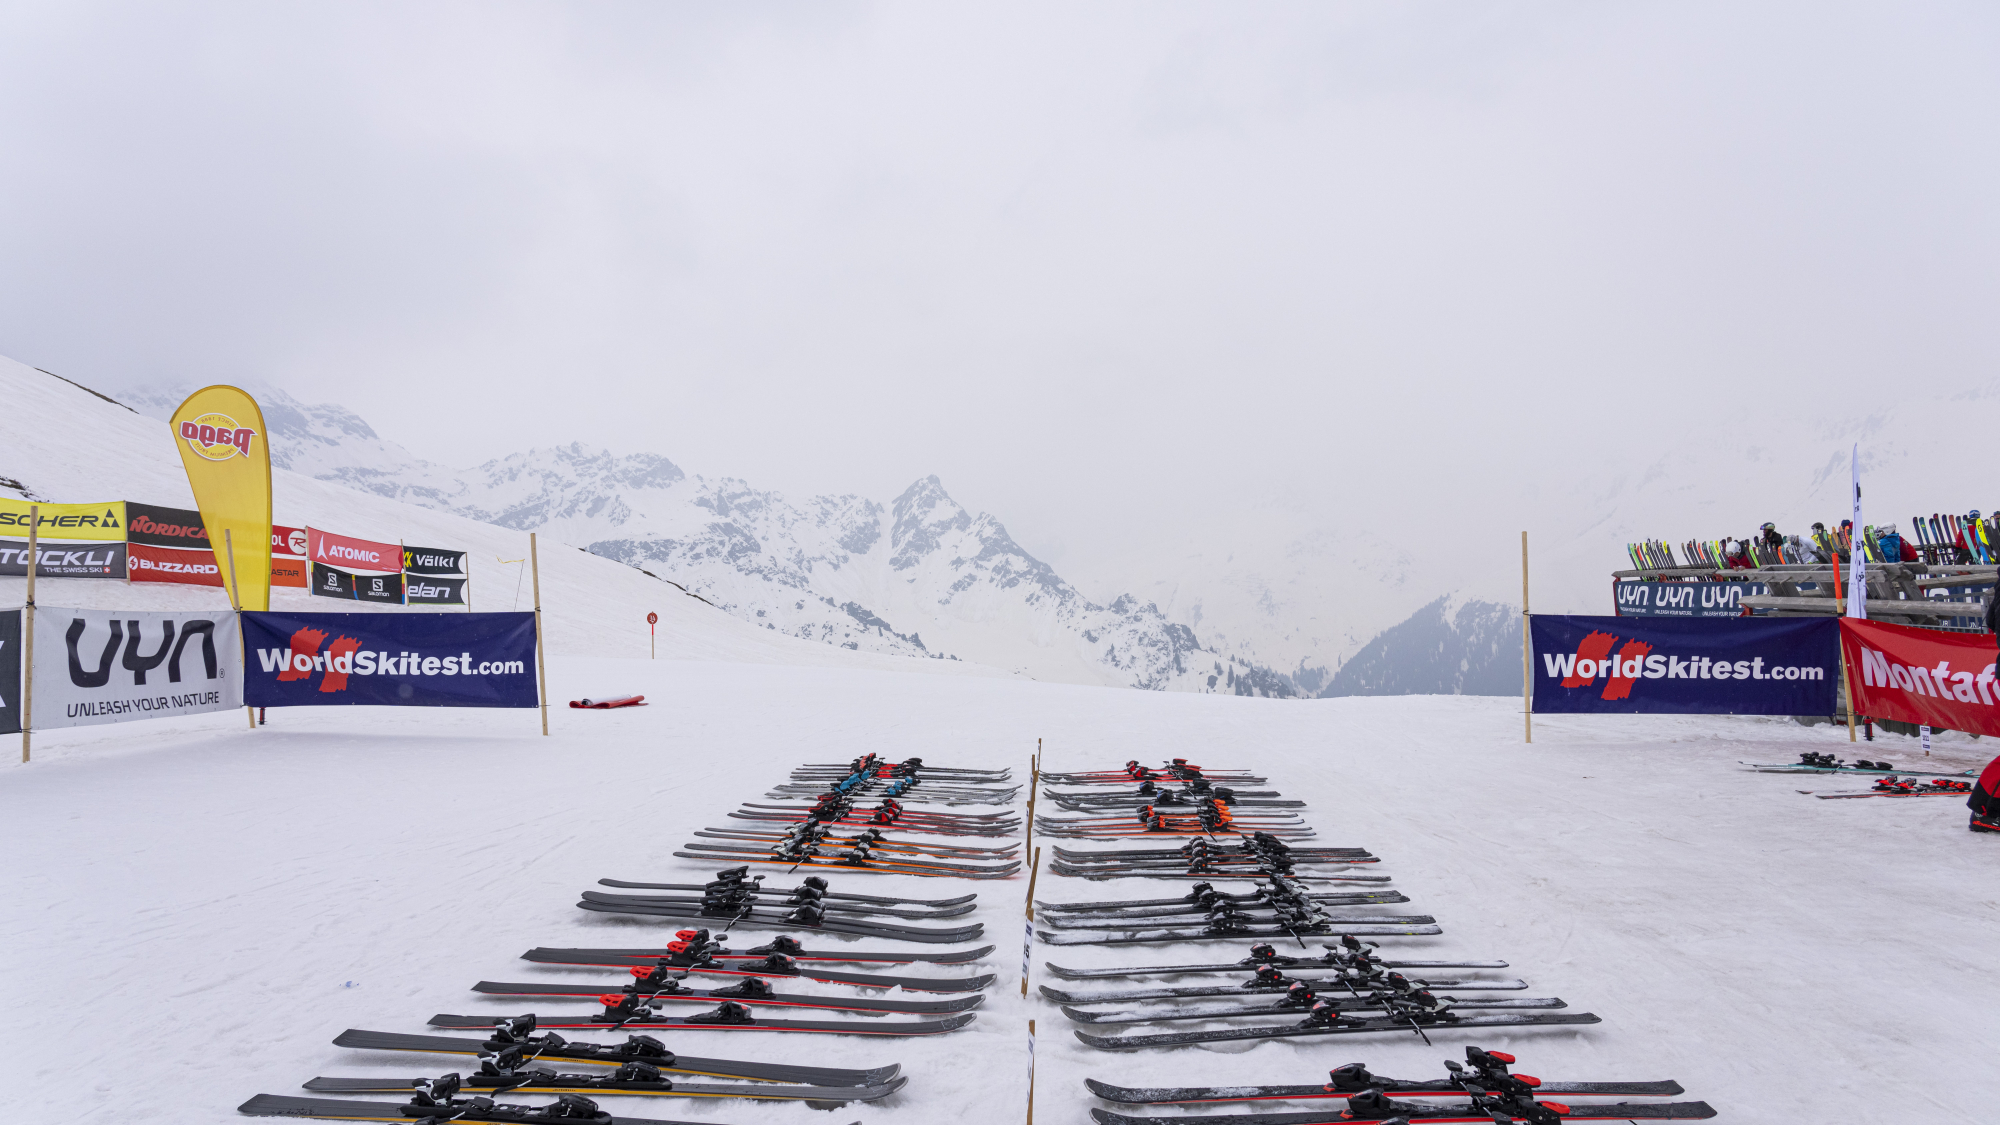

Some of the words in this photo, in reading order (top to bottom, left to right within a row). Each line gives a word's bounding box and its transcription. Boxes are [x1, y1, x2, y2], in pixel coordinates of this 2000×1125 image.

[129, 515, 209, 540] NORDICA
[329, 545, 380, 563] ATOMIC
[416, 554, 454, 568] Völkl
[140, 558, 219, 574] BLIZZARD
[271, 568, 299, 577] ASTAR
[408, 582, 451, 598] elan
[257, 648, 524, 676] WorldSkitest.com
[1543, 653, 1824, 680] WorldSkitest.com
[67, 700, 131, 718] UNLEASH
[135, 697, 170, 712] YOUR
[171, 691, 219, 708] NATURE
